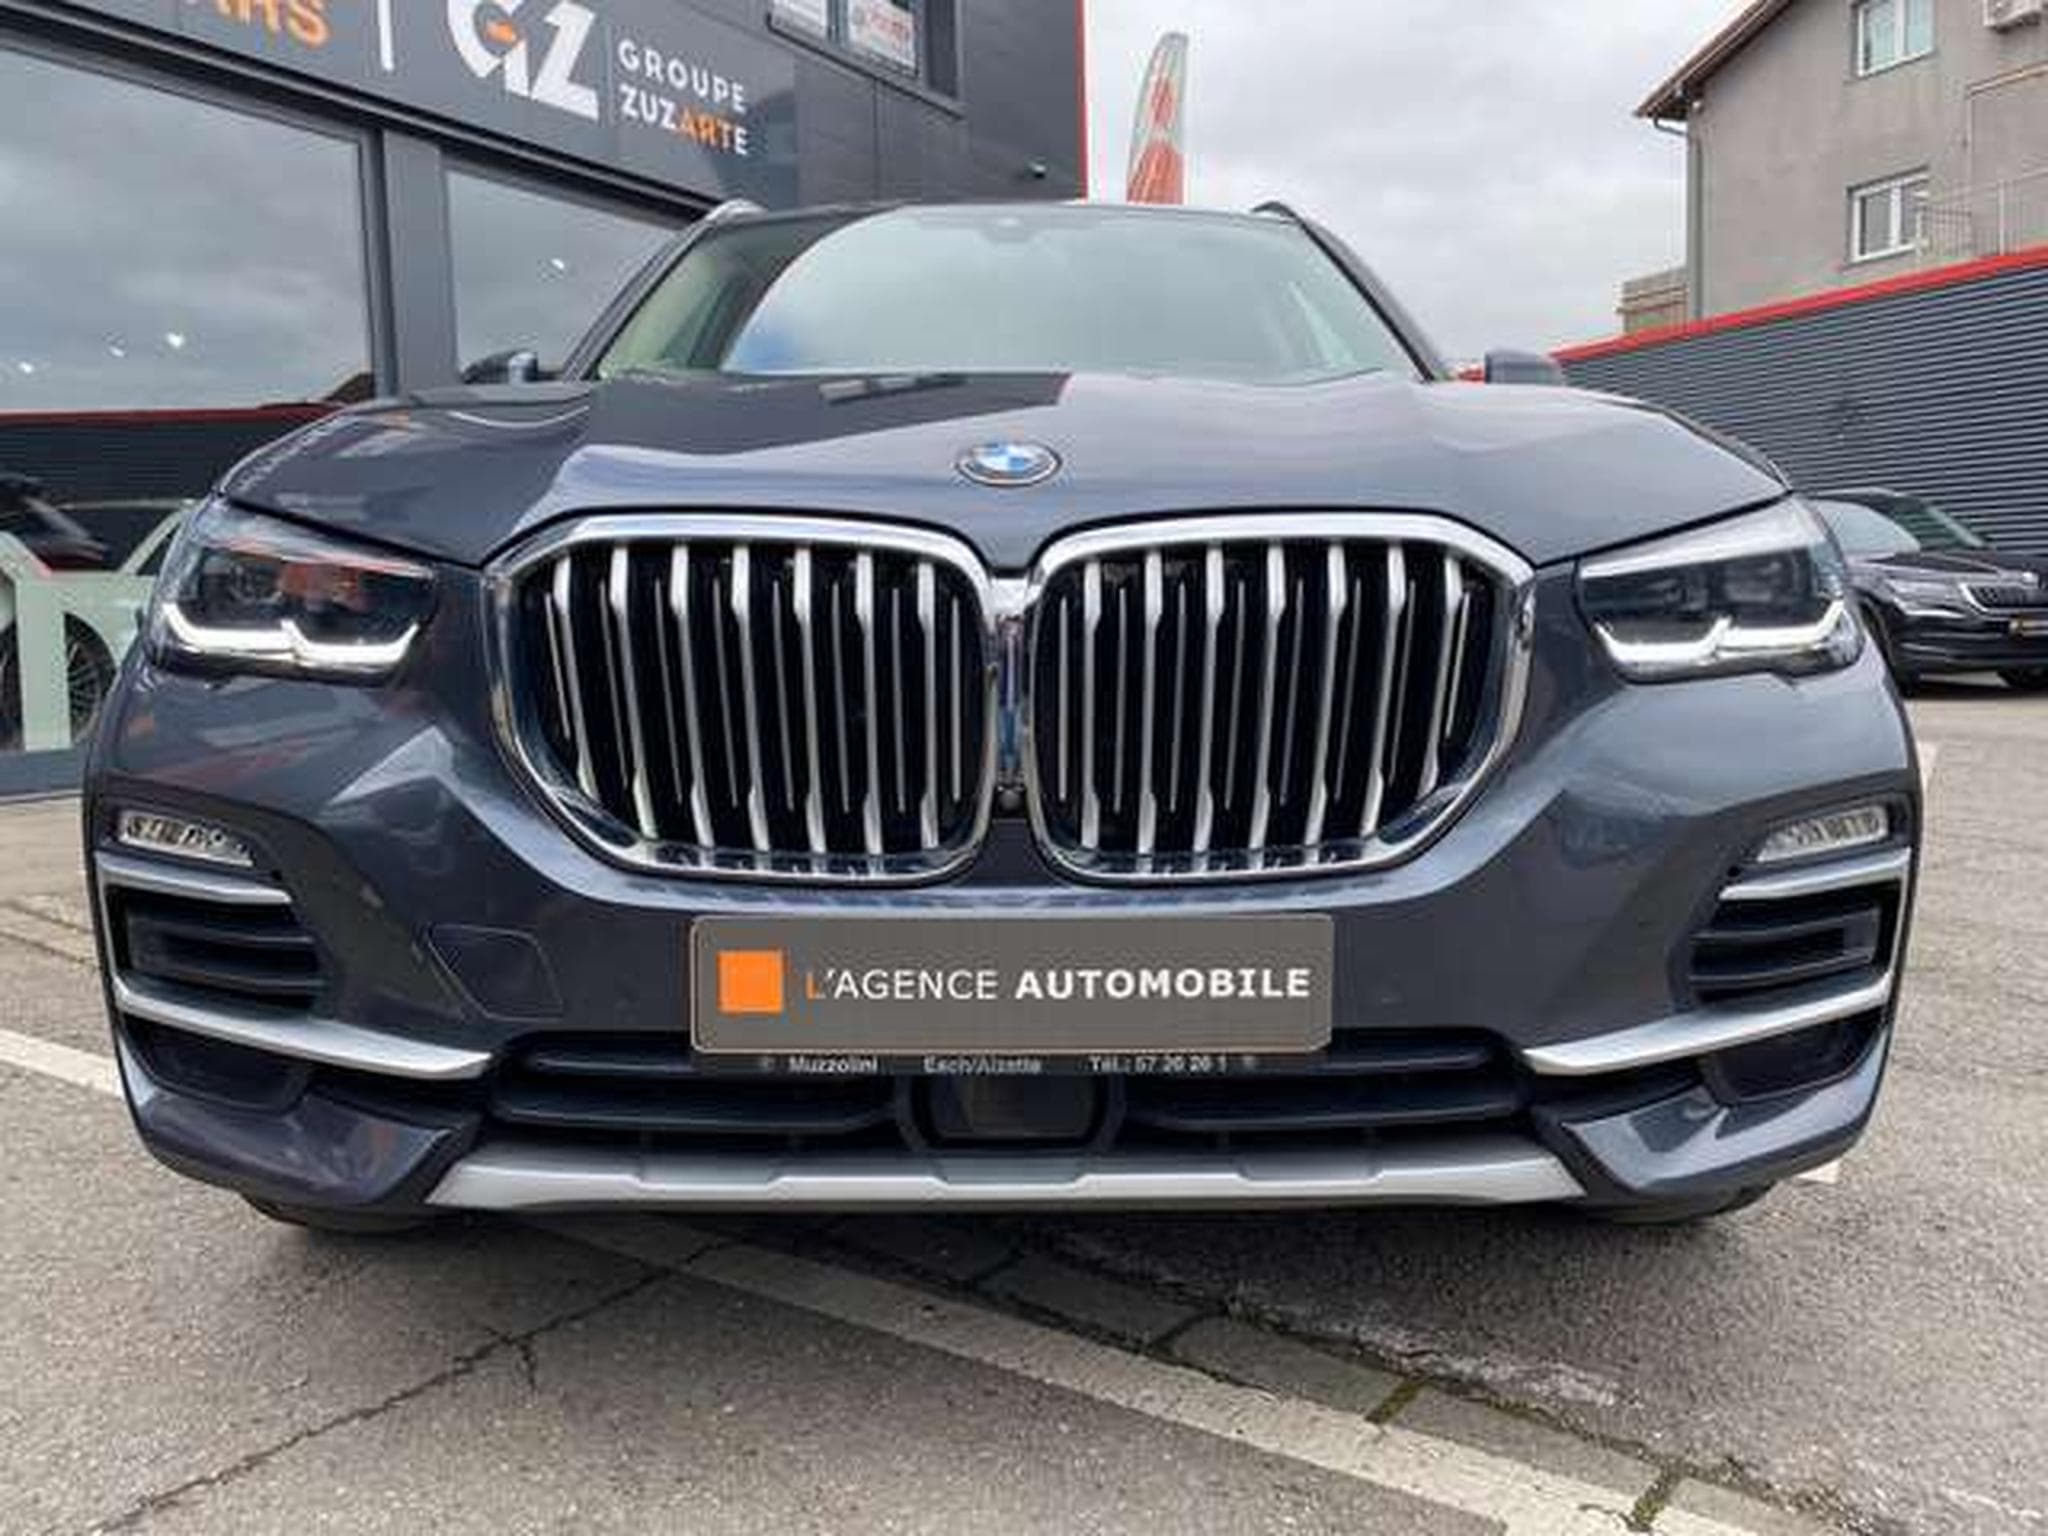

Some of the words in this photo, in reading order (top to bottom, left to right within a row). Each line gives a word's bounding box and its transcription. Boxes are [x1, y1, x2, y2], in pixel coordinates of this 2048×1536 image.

[618, 39, 746, 114] GROUPE
[619, 82, 748, 156] ZUZARTE
[806, 968, 999, 1000] L'AGENCE
[1014, 967, 1312, 1000] AUTOMOBILE
[788, 1055, 878, 1073] Muzzolini
